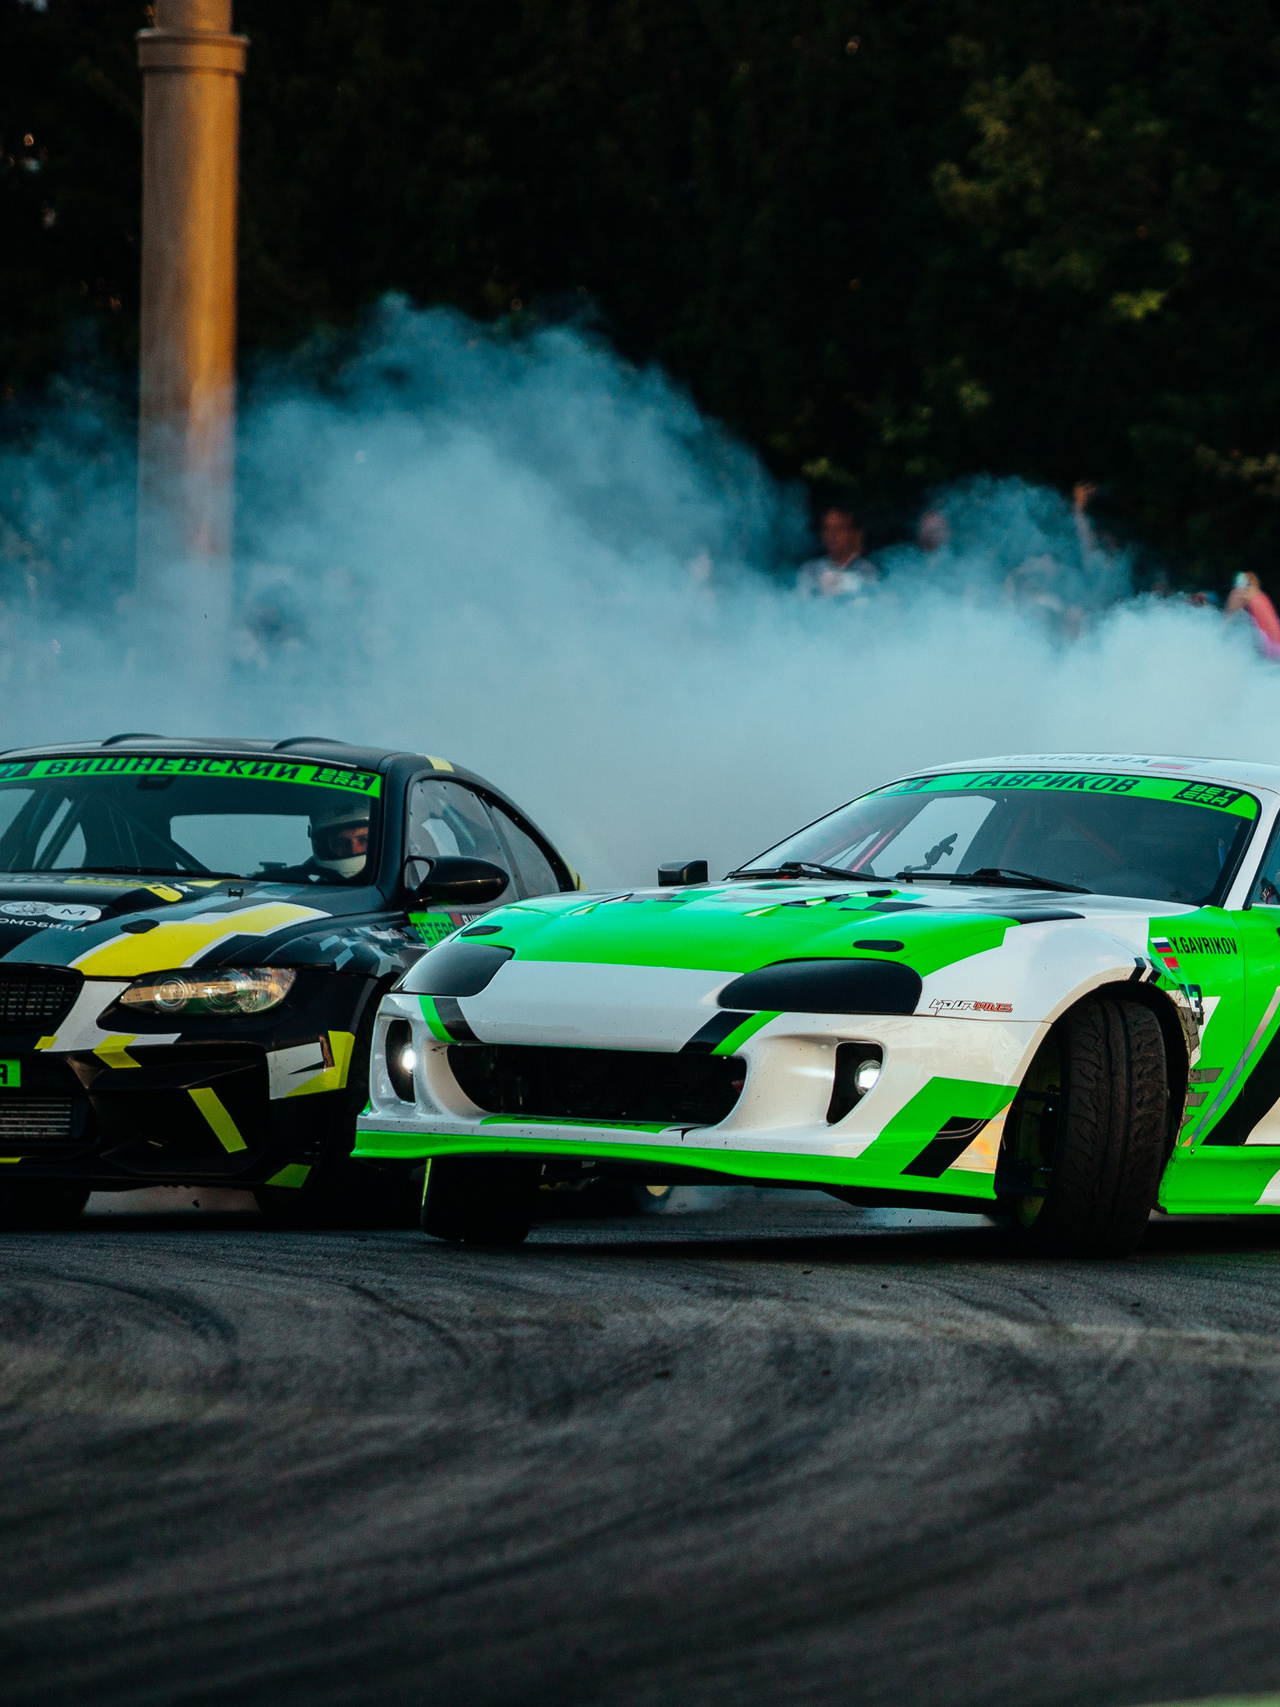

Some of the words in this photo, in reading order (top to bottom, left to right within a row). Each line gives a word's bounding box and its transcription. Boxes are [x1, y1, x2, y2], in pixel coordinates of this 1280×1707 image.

[963, 774, 1141, 792] ГАВРИКОВ
[1195, 783, 1239, 798] BET
[1169, 936, 1238, 954] Y.GAVRIKOV
